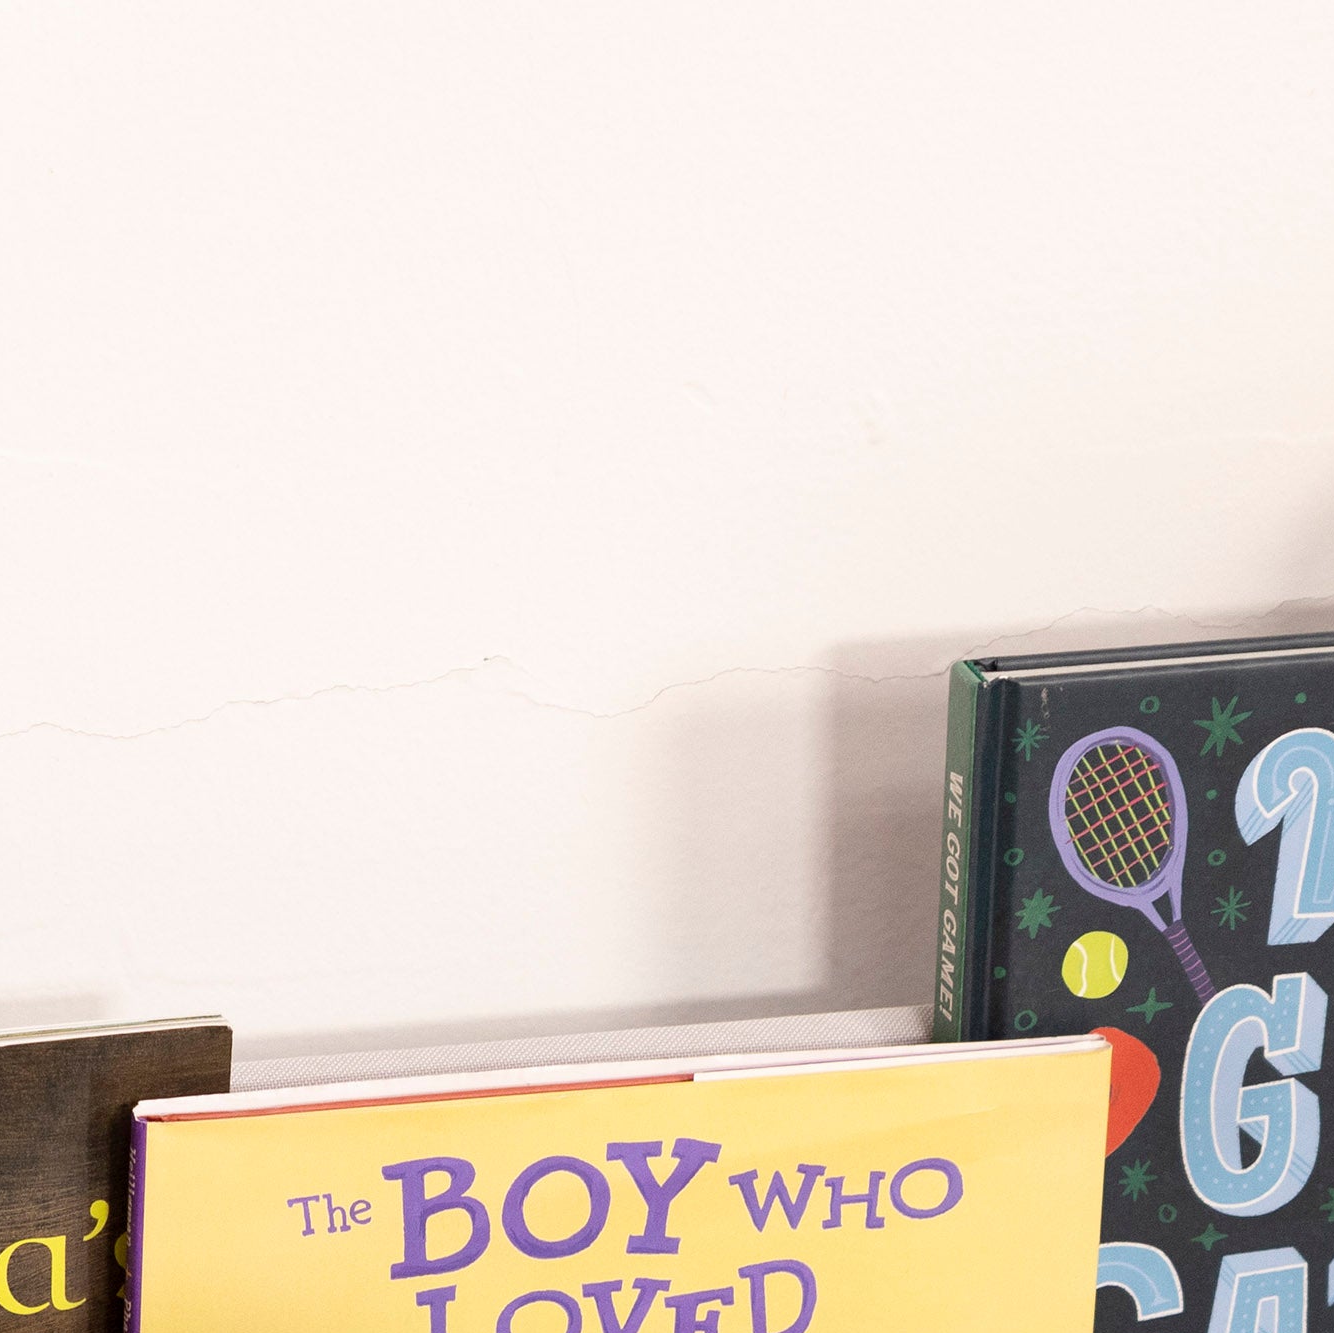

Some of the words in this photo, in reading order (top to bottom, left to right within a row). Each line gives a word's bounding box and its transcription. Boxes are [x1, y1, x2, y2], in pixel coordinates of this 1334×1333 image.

[947, 770, 964, 828] WE
[944, 831, 961, 906] GOT
[938, 908, 958, 1022] GAME!
[286, 1193, 373, 1238] The
[381, 1137, 722, 1281] BOY
[728, 1156, 965, 1233] WHO
